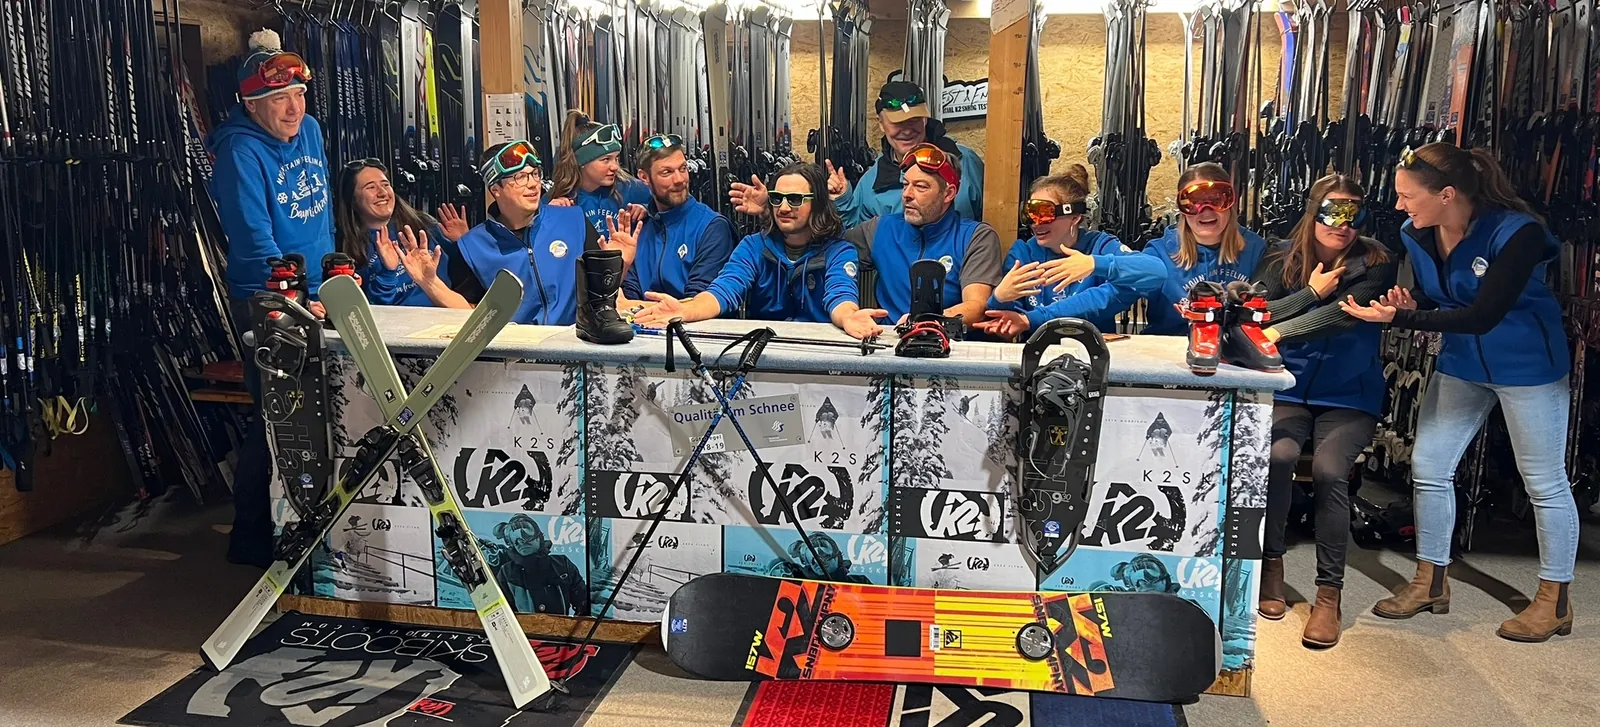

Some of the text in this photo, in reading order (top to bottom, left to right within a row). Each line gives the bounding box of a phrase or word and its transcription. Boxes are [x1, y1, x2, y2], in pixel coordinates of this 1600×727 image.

[343, 70, 352, 120] MADSHUS
[192, 137, 213, 181] ADSHUS
[749, 402, 795, 416] Schnee
[691, 442, 725, 452] 218-19
[819, 583, 837, 622] MPNY
[1093, 596, 1113, 638] 157W
[280, 627, 493, 663] SKIBOOTS
[744, 629, 764, 671] 157W
[1048, 650, 1067, 693] MPNY
